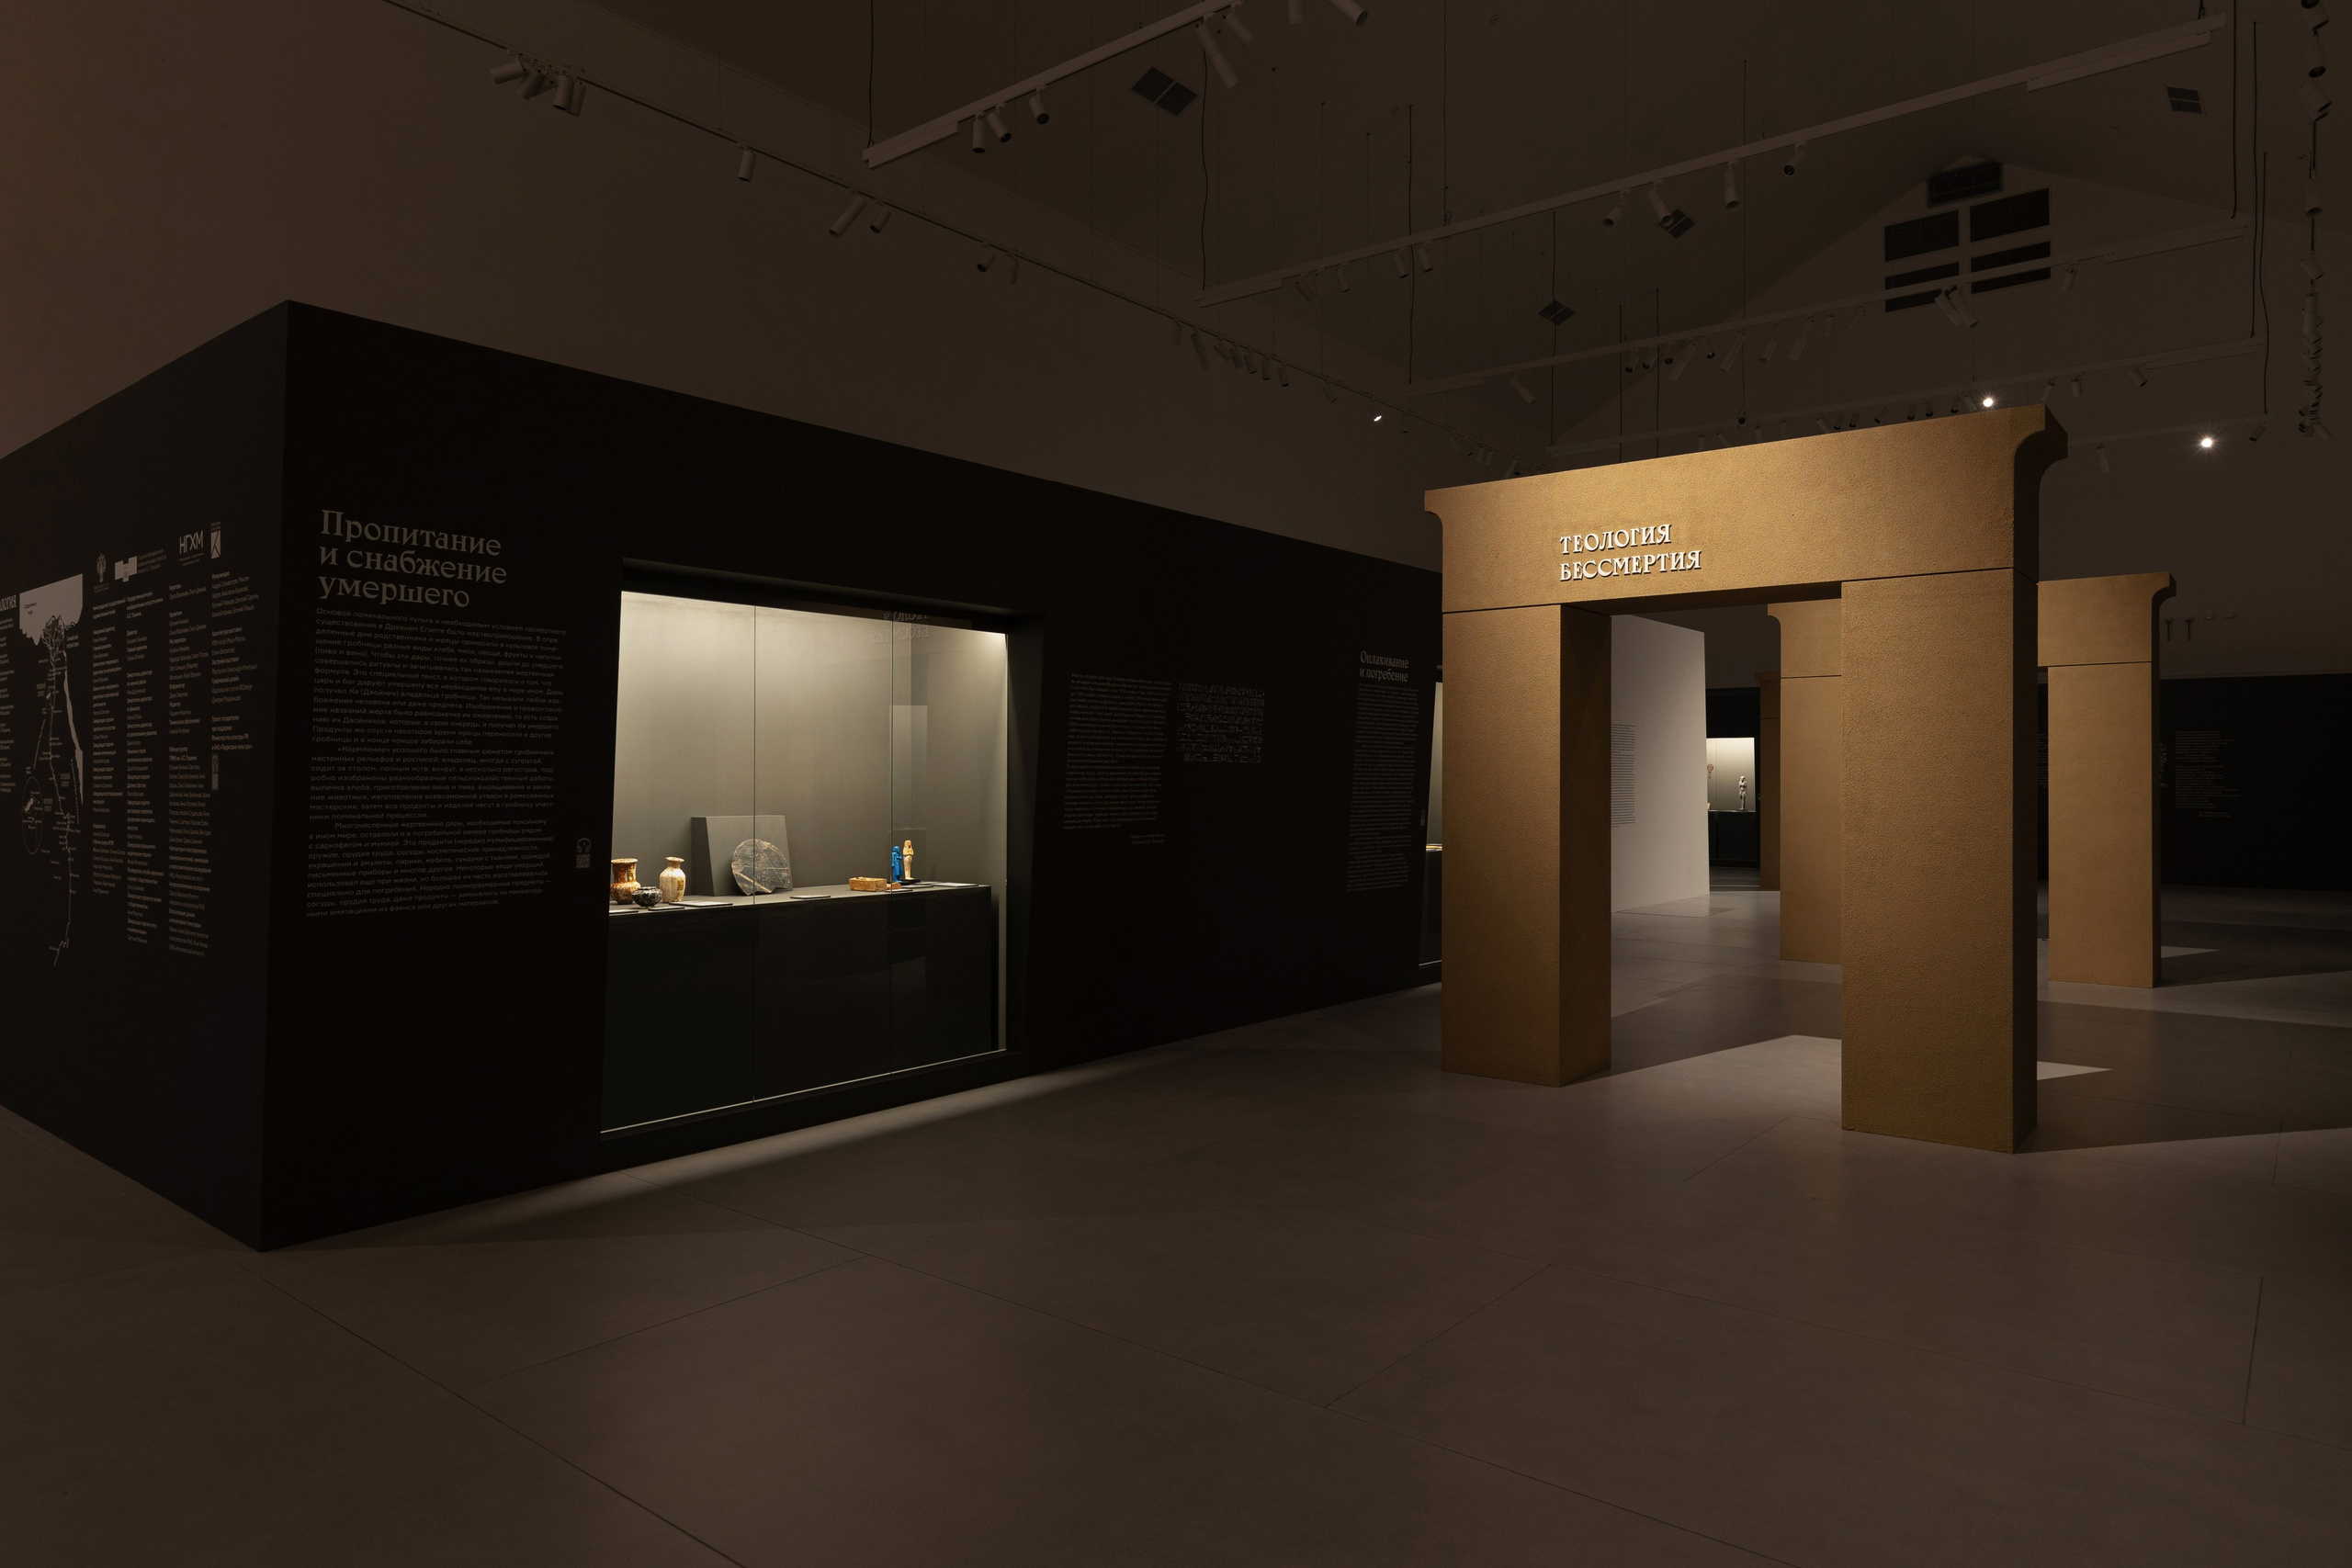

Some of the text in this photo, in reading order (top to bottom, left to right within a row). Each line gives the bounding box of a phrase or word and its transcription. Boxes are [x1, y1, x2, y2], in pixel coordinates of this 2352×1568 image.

[179, 530, 203, 554] НГХМ
[321, 509, 502, 557] Пропитание
[1560, 524, 1672, 554] ТЕОЛОГИЯ
[319, 546, 507, 584] и снабжение
[1560, 550, 1702, 581] БЕССМЕРТИЯ
[318, 575, 470, 607] умершего
[1360, 650, 1409, 669] Оплакивание
[1359, 668, 1408, 682] и погребение
